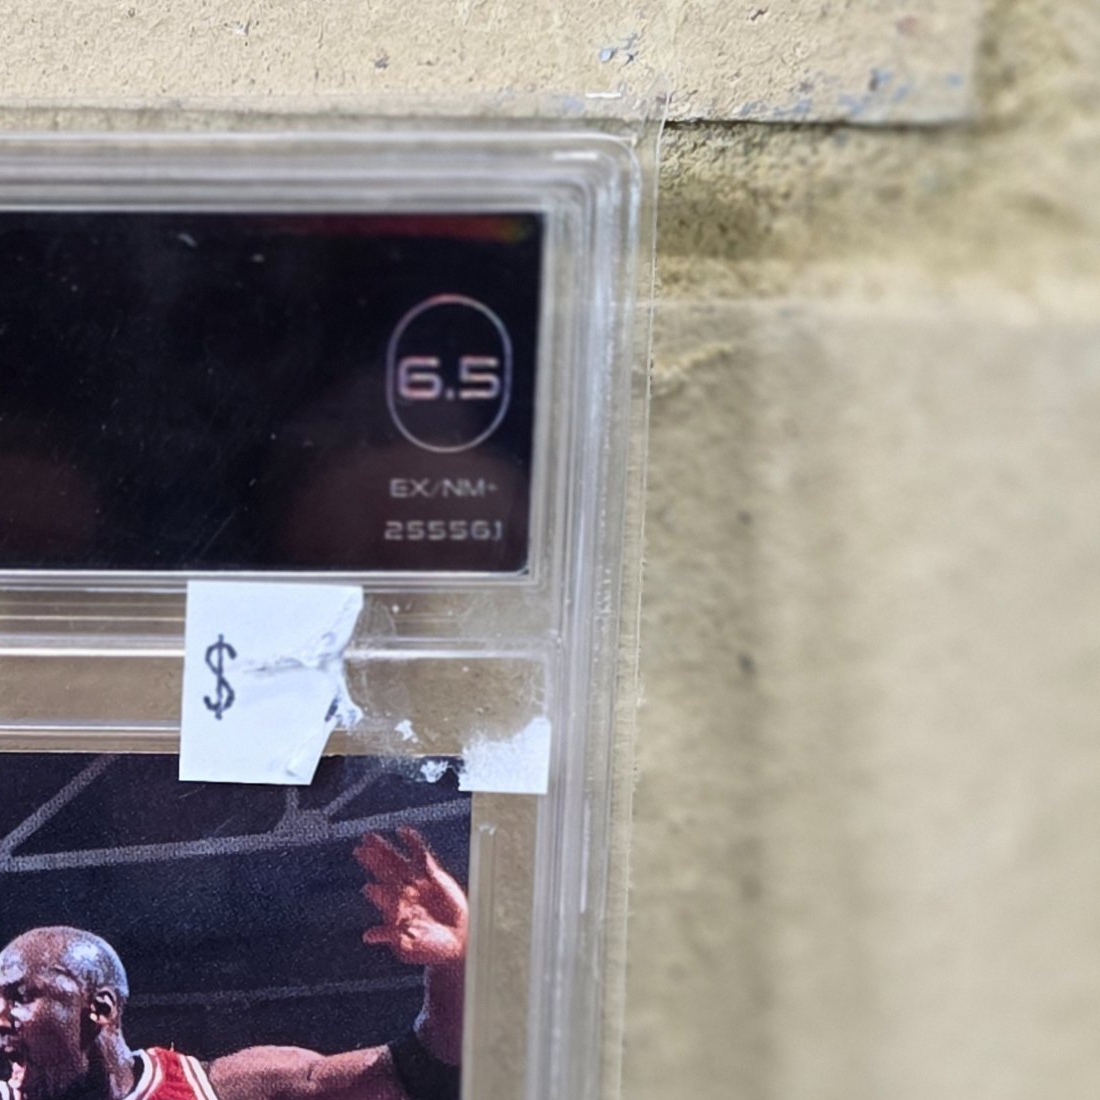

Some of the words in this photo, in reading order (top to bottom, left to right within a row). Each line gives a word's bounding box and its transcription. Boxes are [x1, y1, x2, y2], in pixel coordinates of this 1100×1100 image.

[398, 355, 502, 400] 6.5
[384, 520, 503, 541] 255561
[204, 634, 237, 721] $
